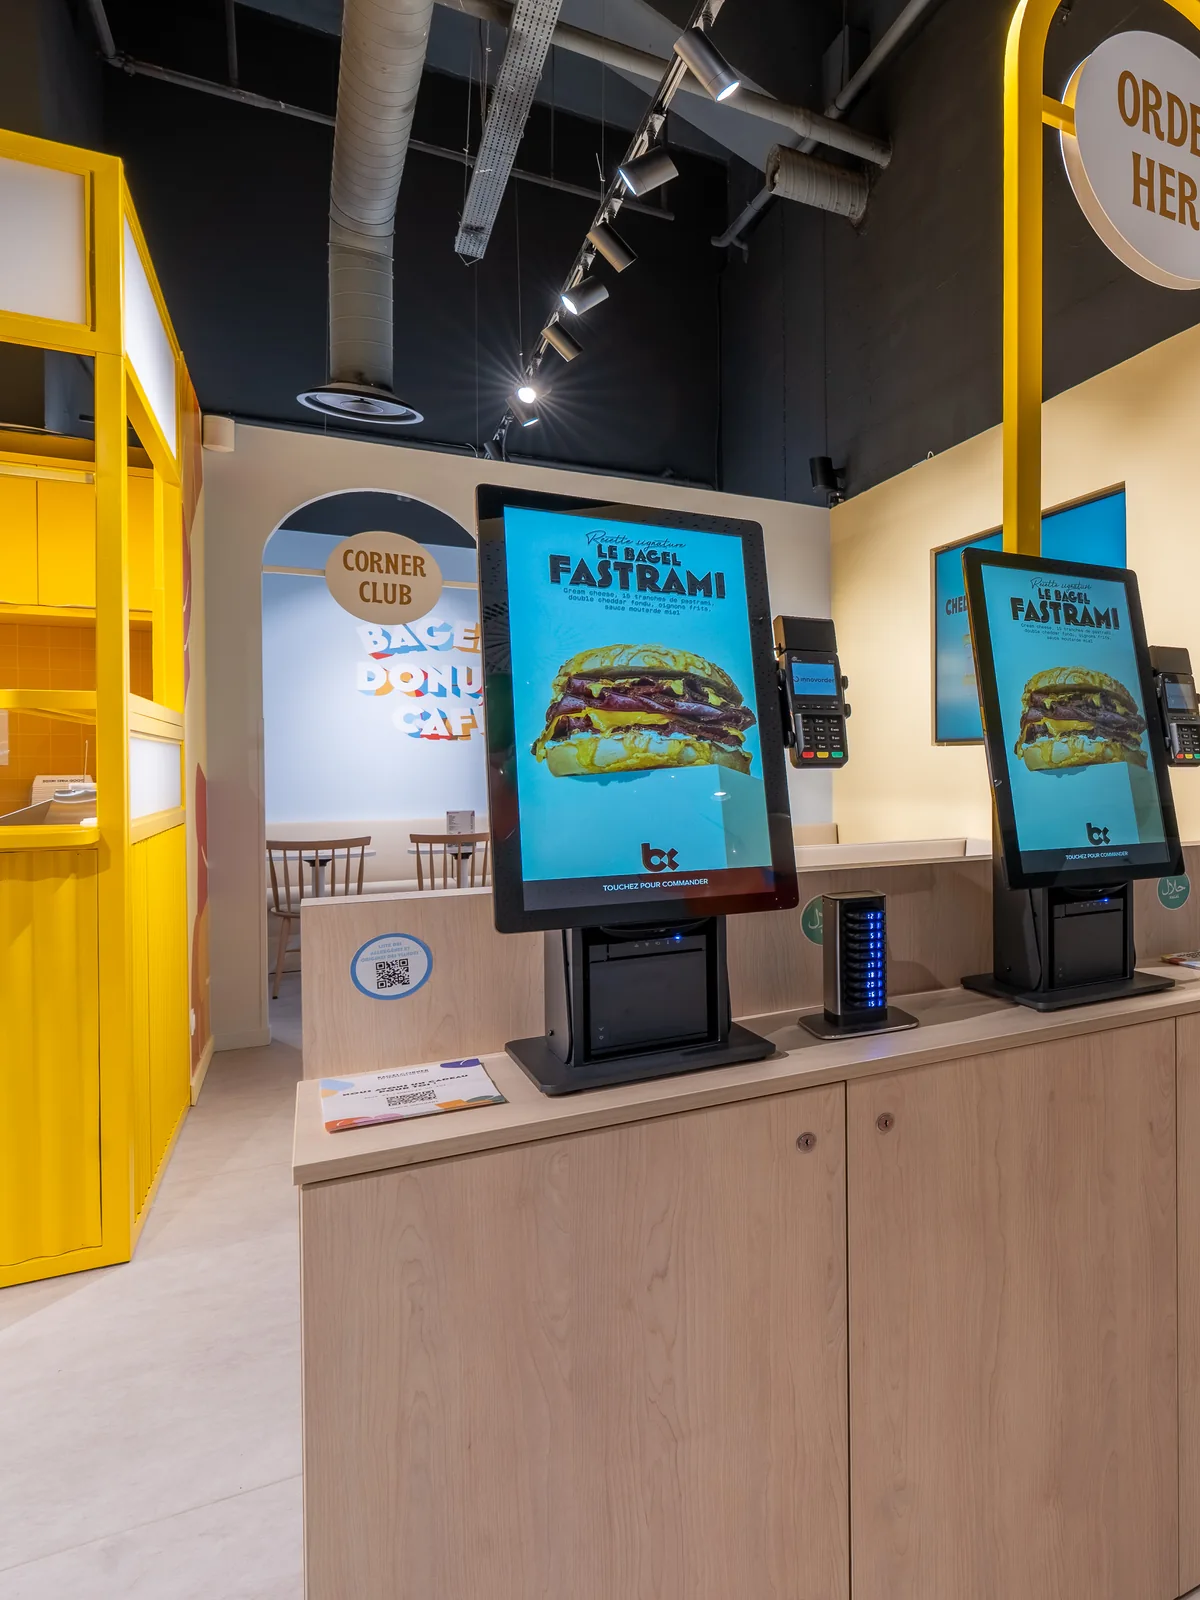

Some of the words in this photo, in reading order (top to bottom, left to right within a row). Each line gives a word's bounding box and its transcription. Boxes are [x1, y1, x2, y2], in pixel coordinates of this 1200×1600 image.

[585, 530, 634, 546] Recette
[635, 538, 687, 551] signature
[342, 549, 427, 577] CORNER
[597, 543, 618, 560] LE
[623, 547, 682, 567] BAGEL
[548, 553, 726, 599] FASTRAMI
[358, 580, 412, 605] CLUB
[568, 594, 594, 602] double
[634, 594, 666, 602] tranches
[1037, 587, 1051, 600] LE
[1054, 589, 1091, 604] BAGEL
[1010, 596, 1120, 630] FASTRAMI
[356, 616, 481, 660] BAGE
[603, 882, 639, 892] TOUCHEZ
[640, 881, 660, 889] POUR
[662, 878, 709, 888] COMMANDER
